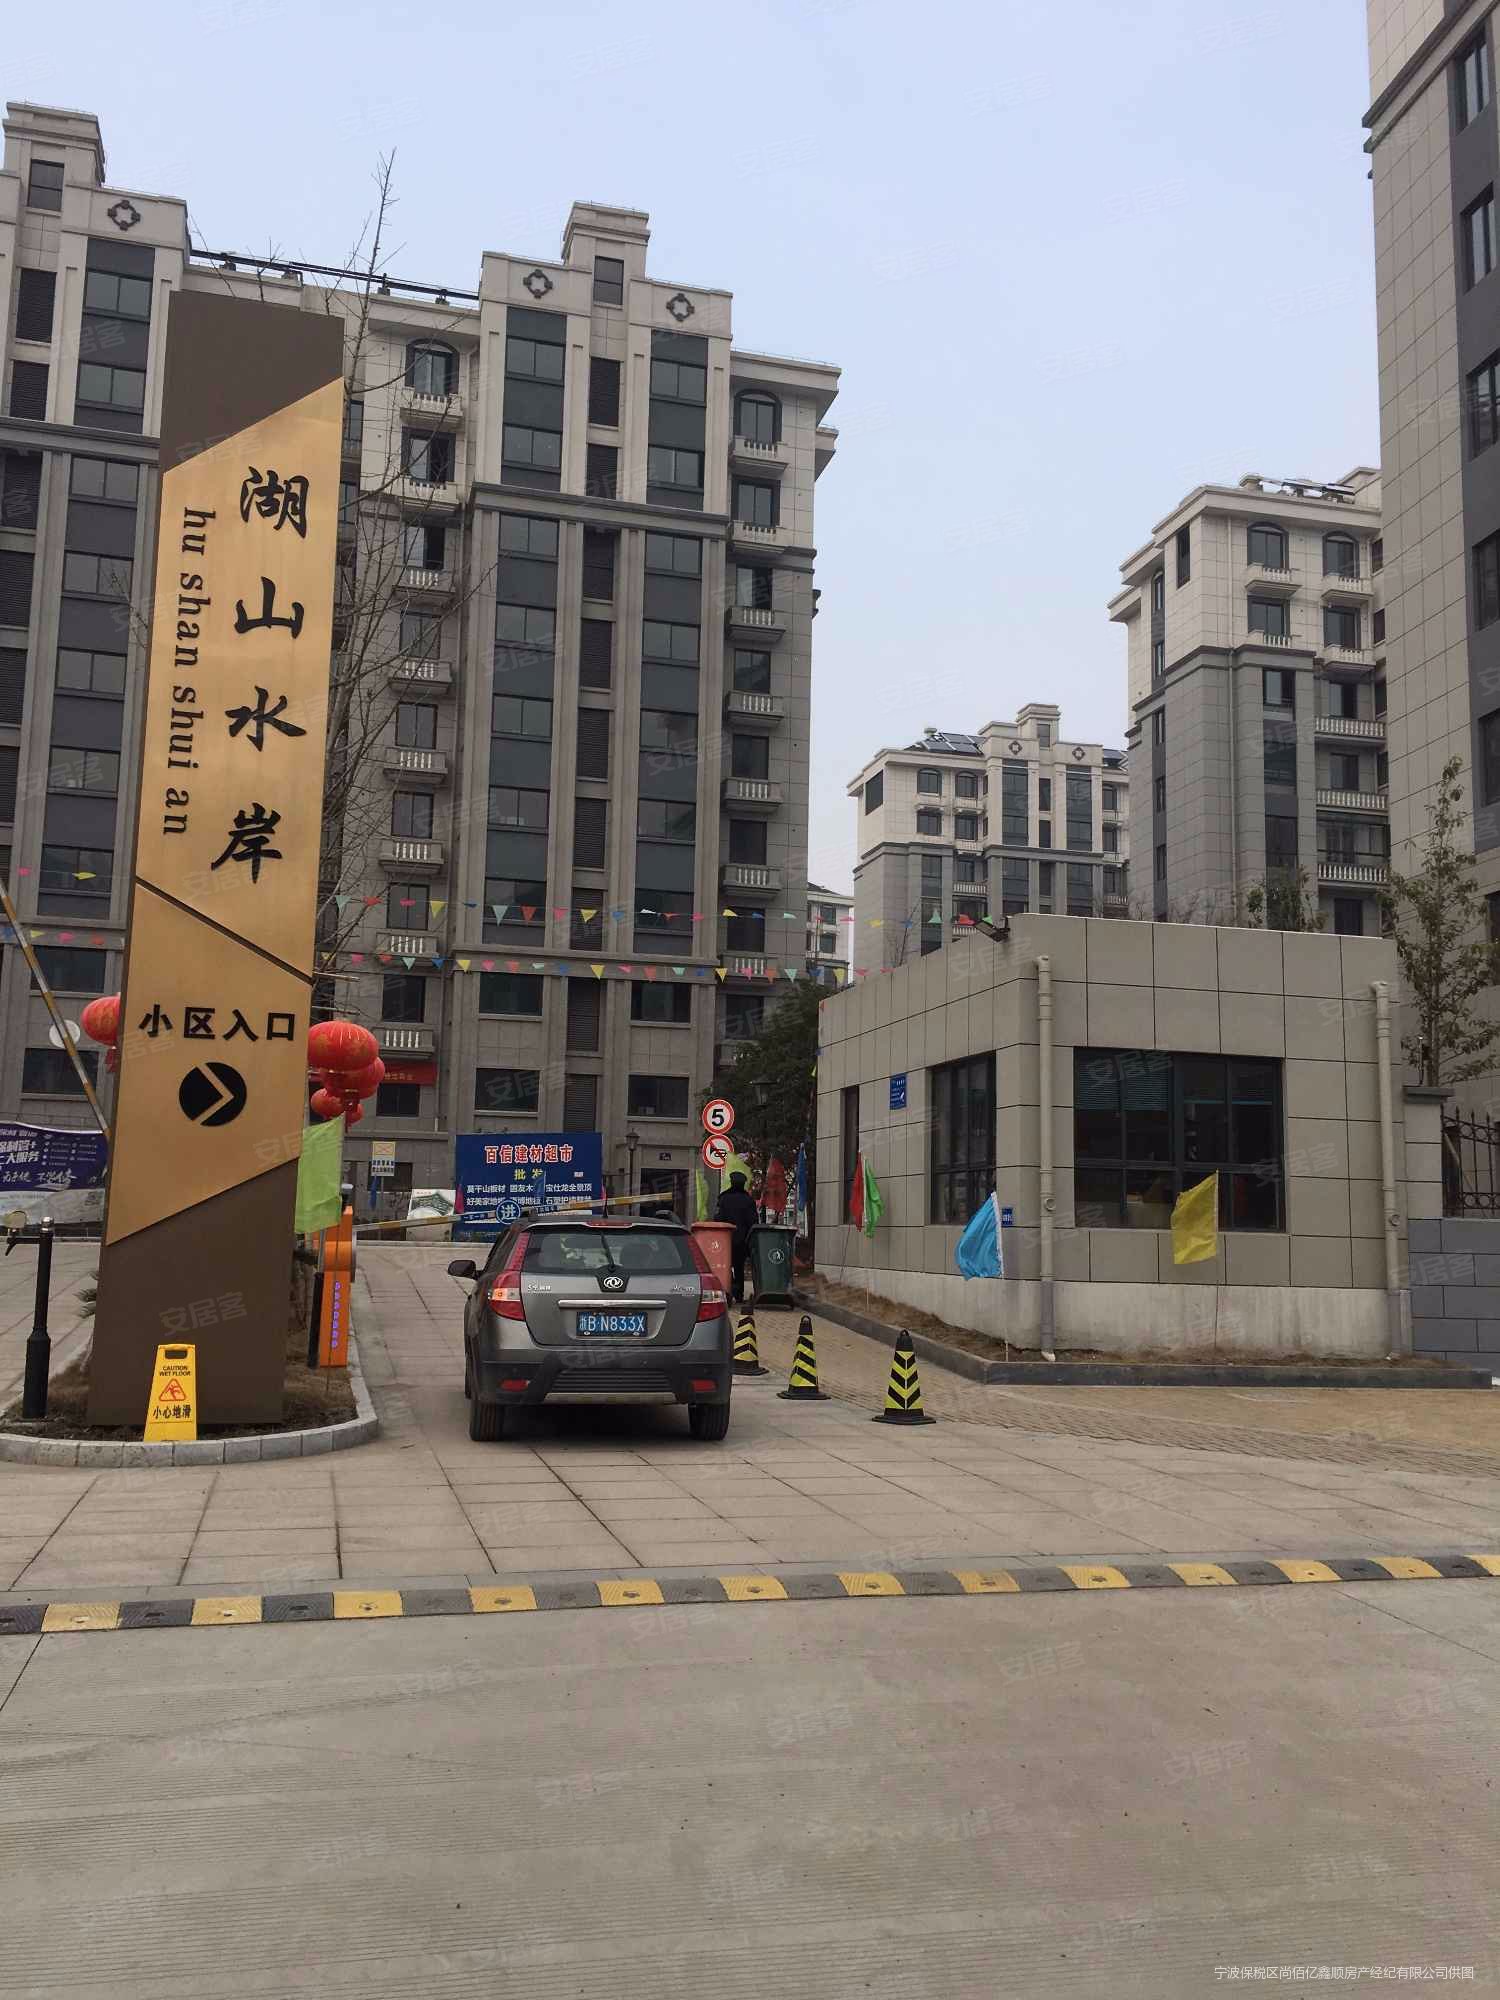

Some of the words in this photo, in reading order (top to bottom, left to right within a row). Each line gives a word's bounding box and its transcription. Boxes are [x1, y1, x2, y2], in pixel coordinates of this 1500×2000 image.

[182, 506, 216, 555] hu
[174, 572, 211, 667] shan
[210, 466, 310, 884] 湖山水岸
[167, 685, 204, 769] shui
[163, 788, 190, 834] an
[137, 1003, 296, 1042] 小区入口
[711, 1108, 725, 1127] 5
[485, 1144, 573, 1163] 百信建材超市
[152, 1404, 192, 1419] 小心地滑
